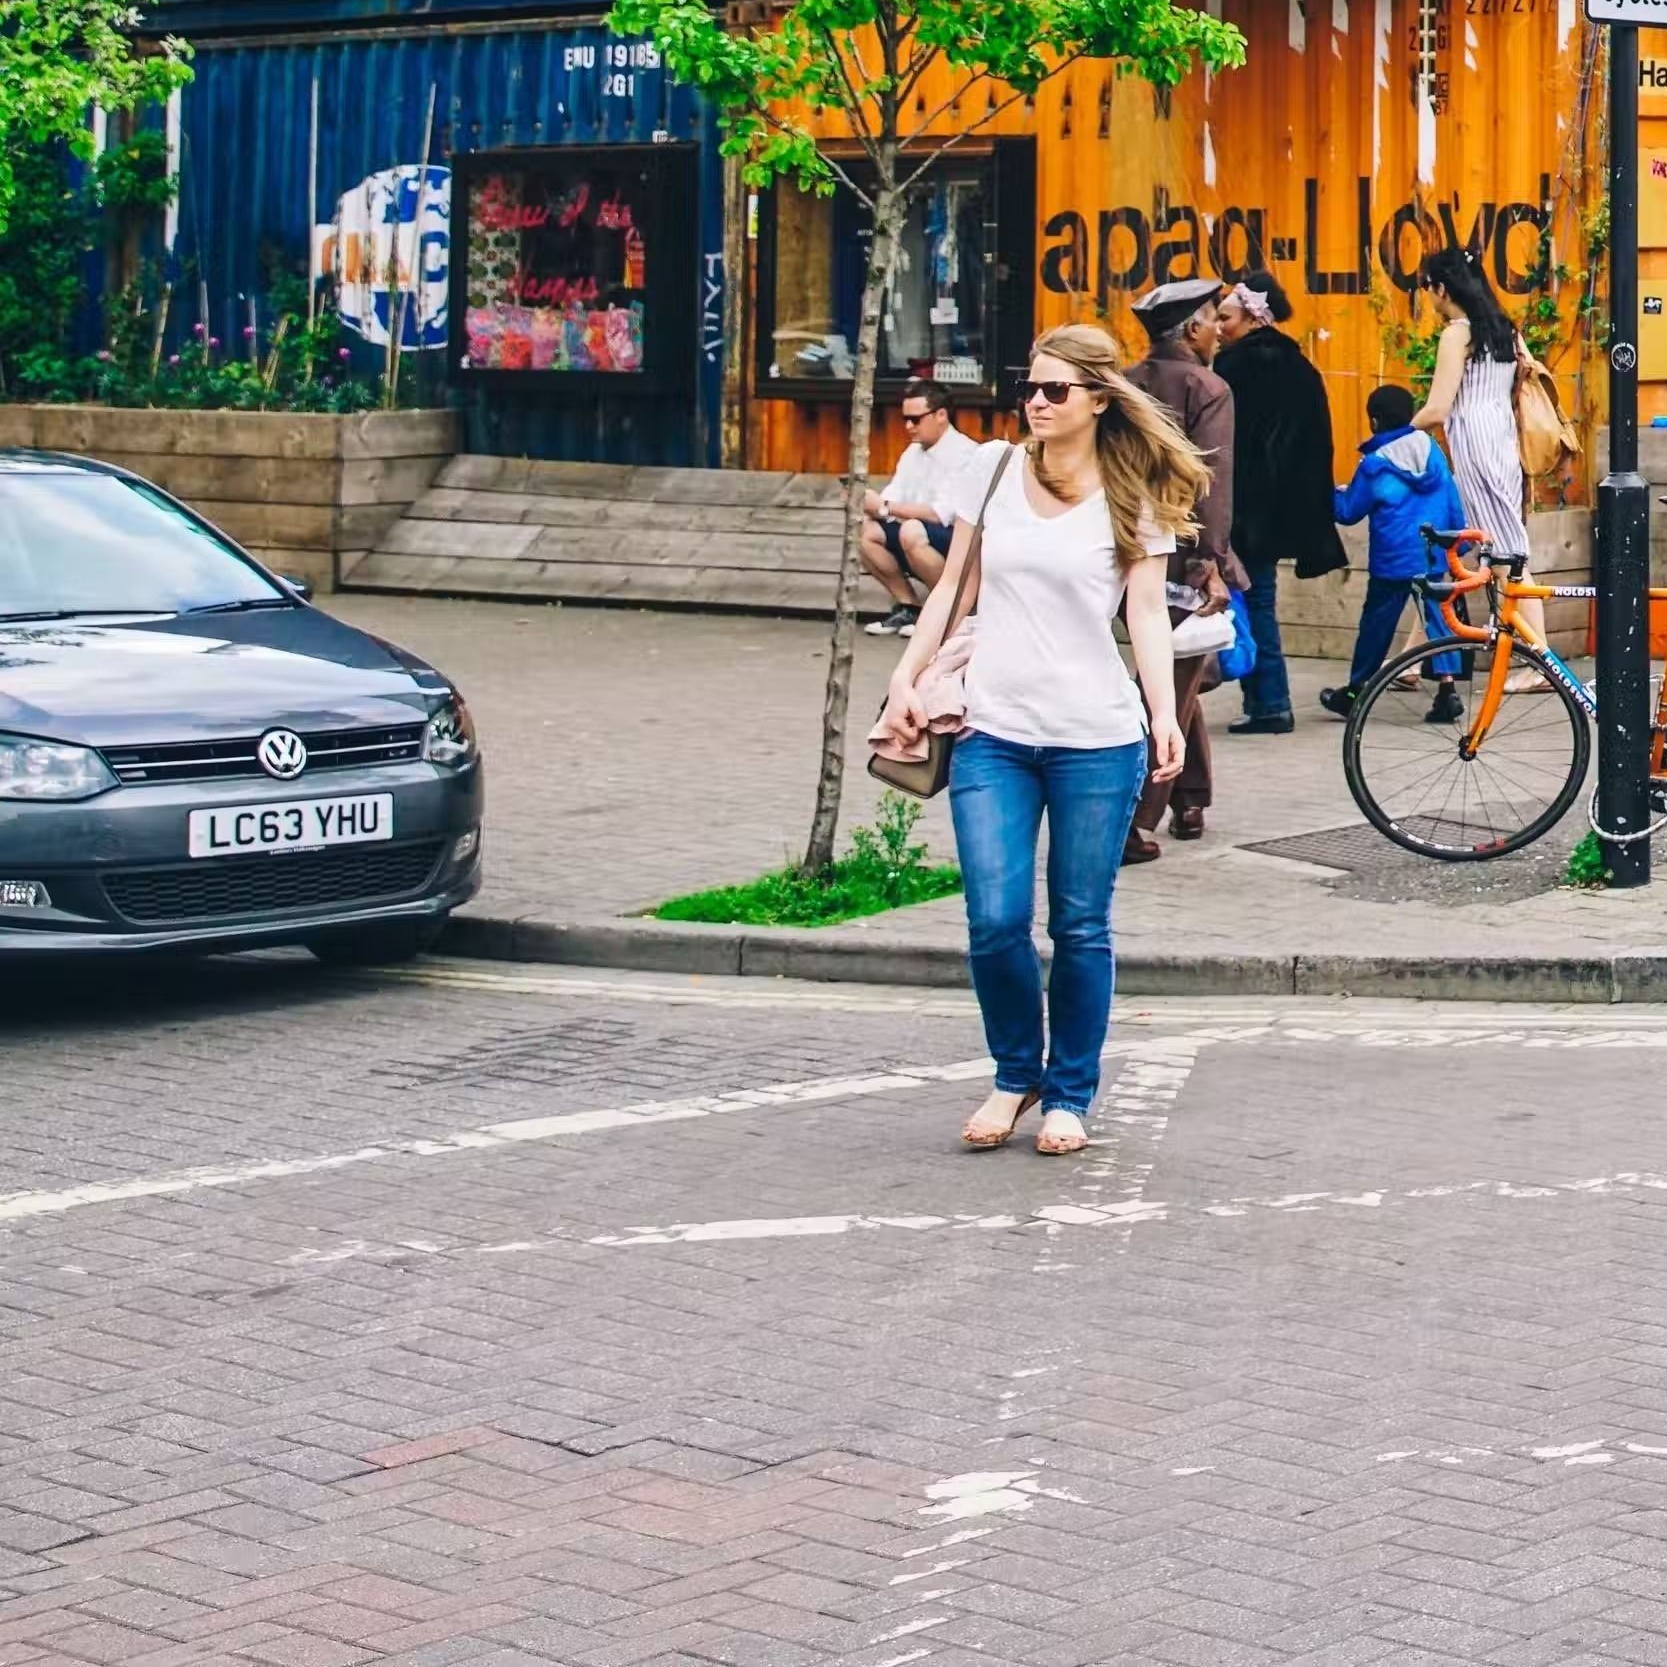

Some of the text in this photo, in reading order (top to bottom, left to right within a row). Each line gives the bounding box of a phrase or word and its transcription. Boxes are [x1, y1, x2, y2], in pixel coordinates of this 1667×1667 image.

[1039, 173, 1552, 317] apag-Lloyd
[209, 800, 378, 849] LC63 YHU
